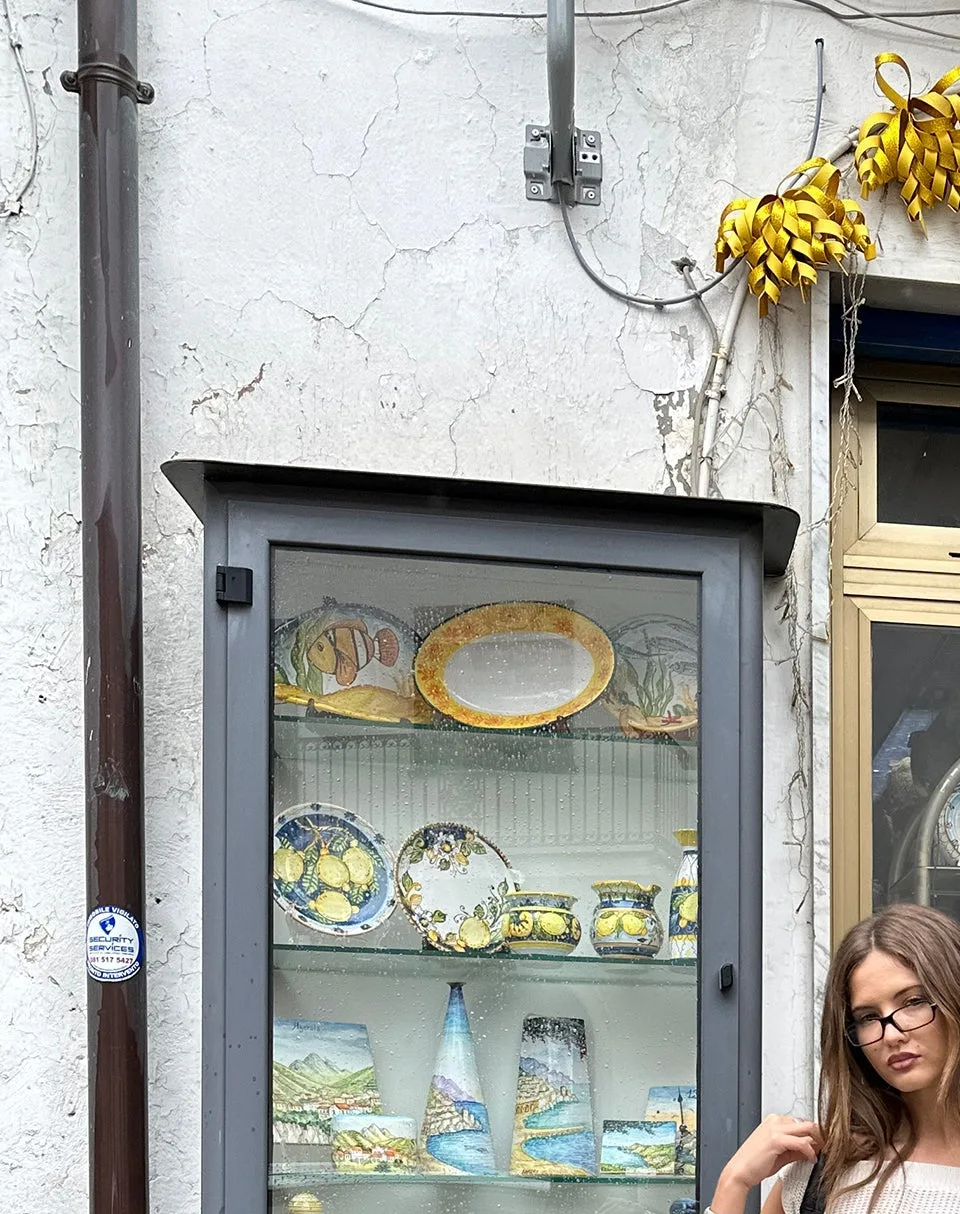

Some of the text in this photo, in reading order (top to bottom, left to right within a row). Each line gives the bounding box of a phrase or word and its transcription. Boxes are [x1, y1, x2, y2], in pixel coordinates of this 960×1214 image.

[112, 906, 139, 929] VIGILATO
[89, 934, 134, 943] SECURITY
[89, 943, 134, 952] SERVICES
